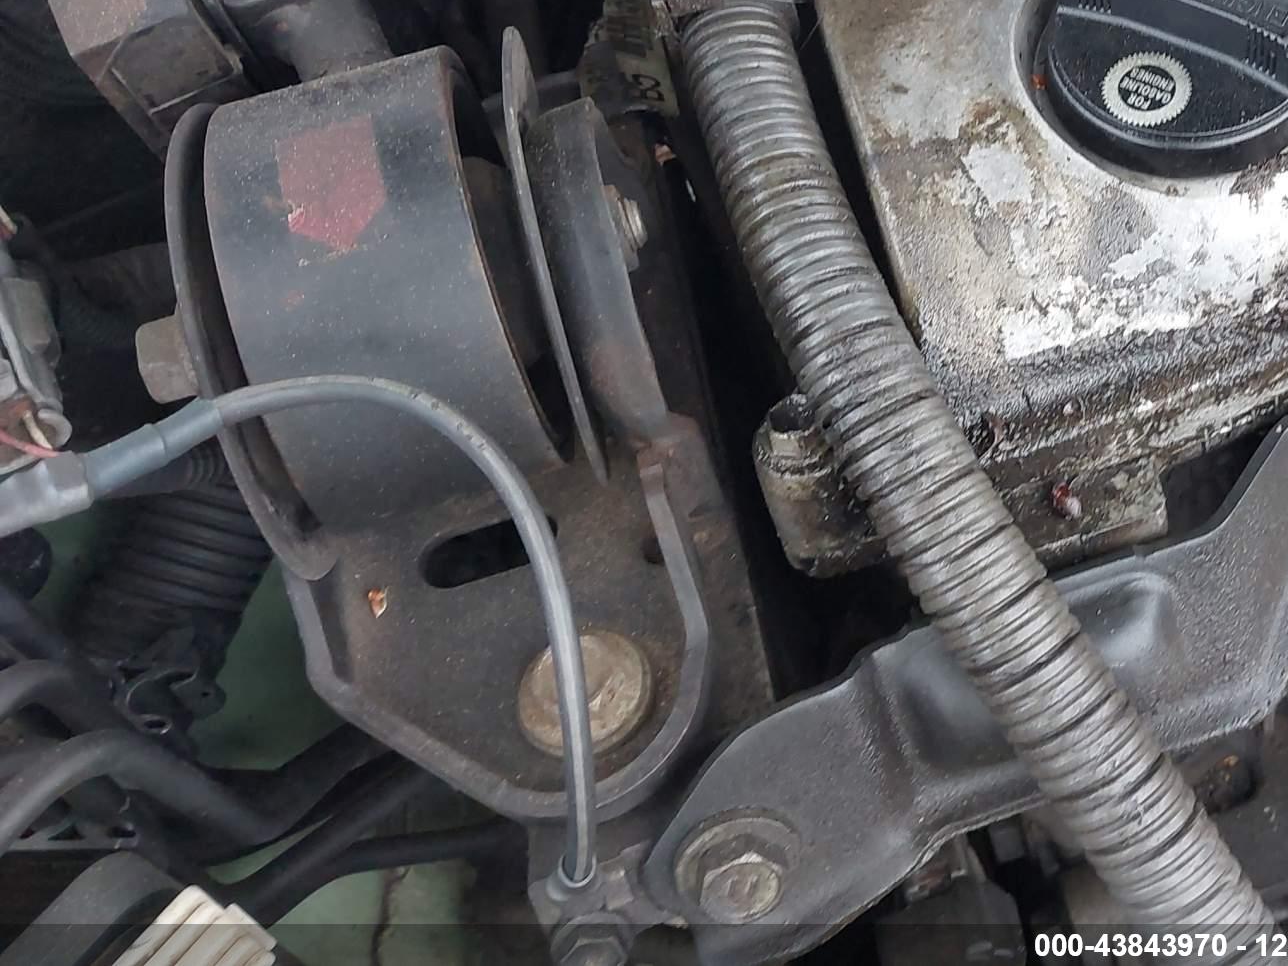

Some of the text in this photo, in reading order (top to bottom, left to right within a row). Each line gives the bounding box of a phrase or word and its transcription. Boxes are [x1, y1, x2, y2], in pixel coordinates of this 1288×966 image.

[1120, 76, 1172, 105] GASOLINE
[1130, 67, 1176, 92] ENGINES
[1126, 92, 1152, 111] FOR
